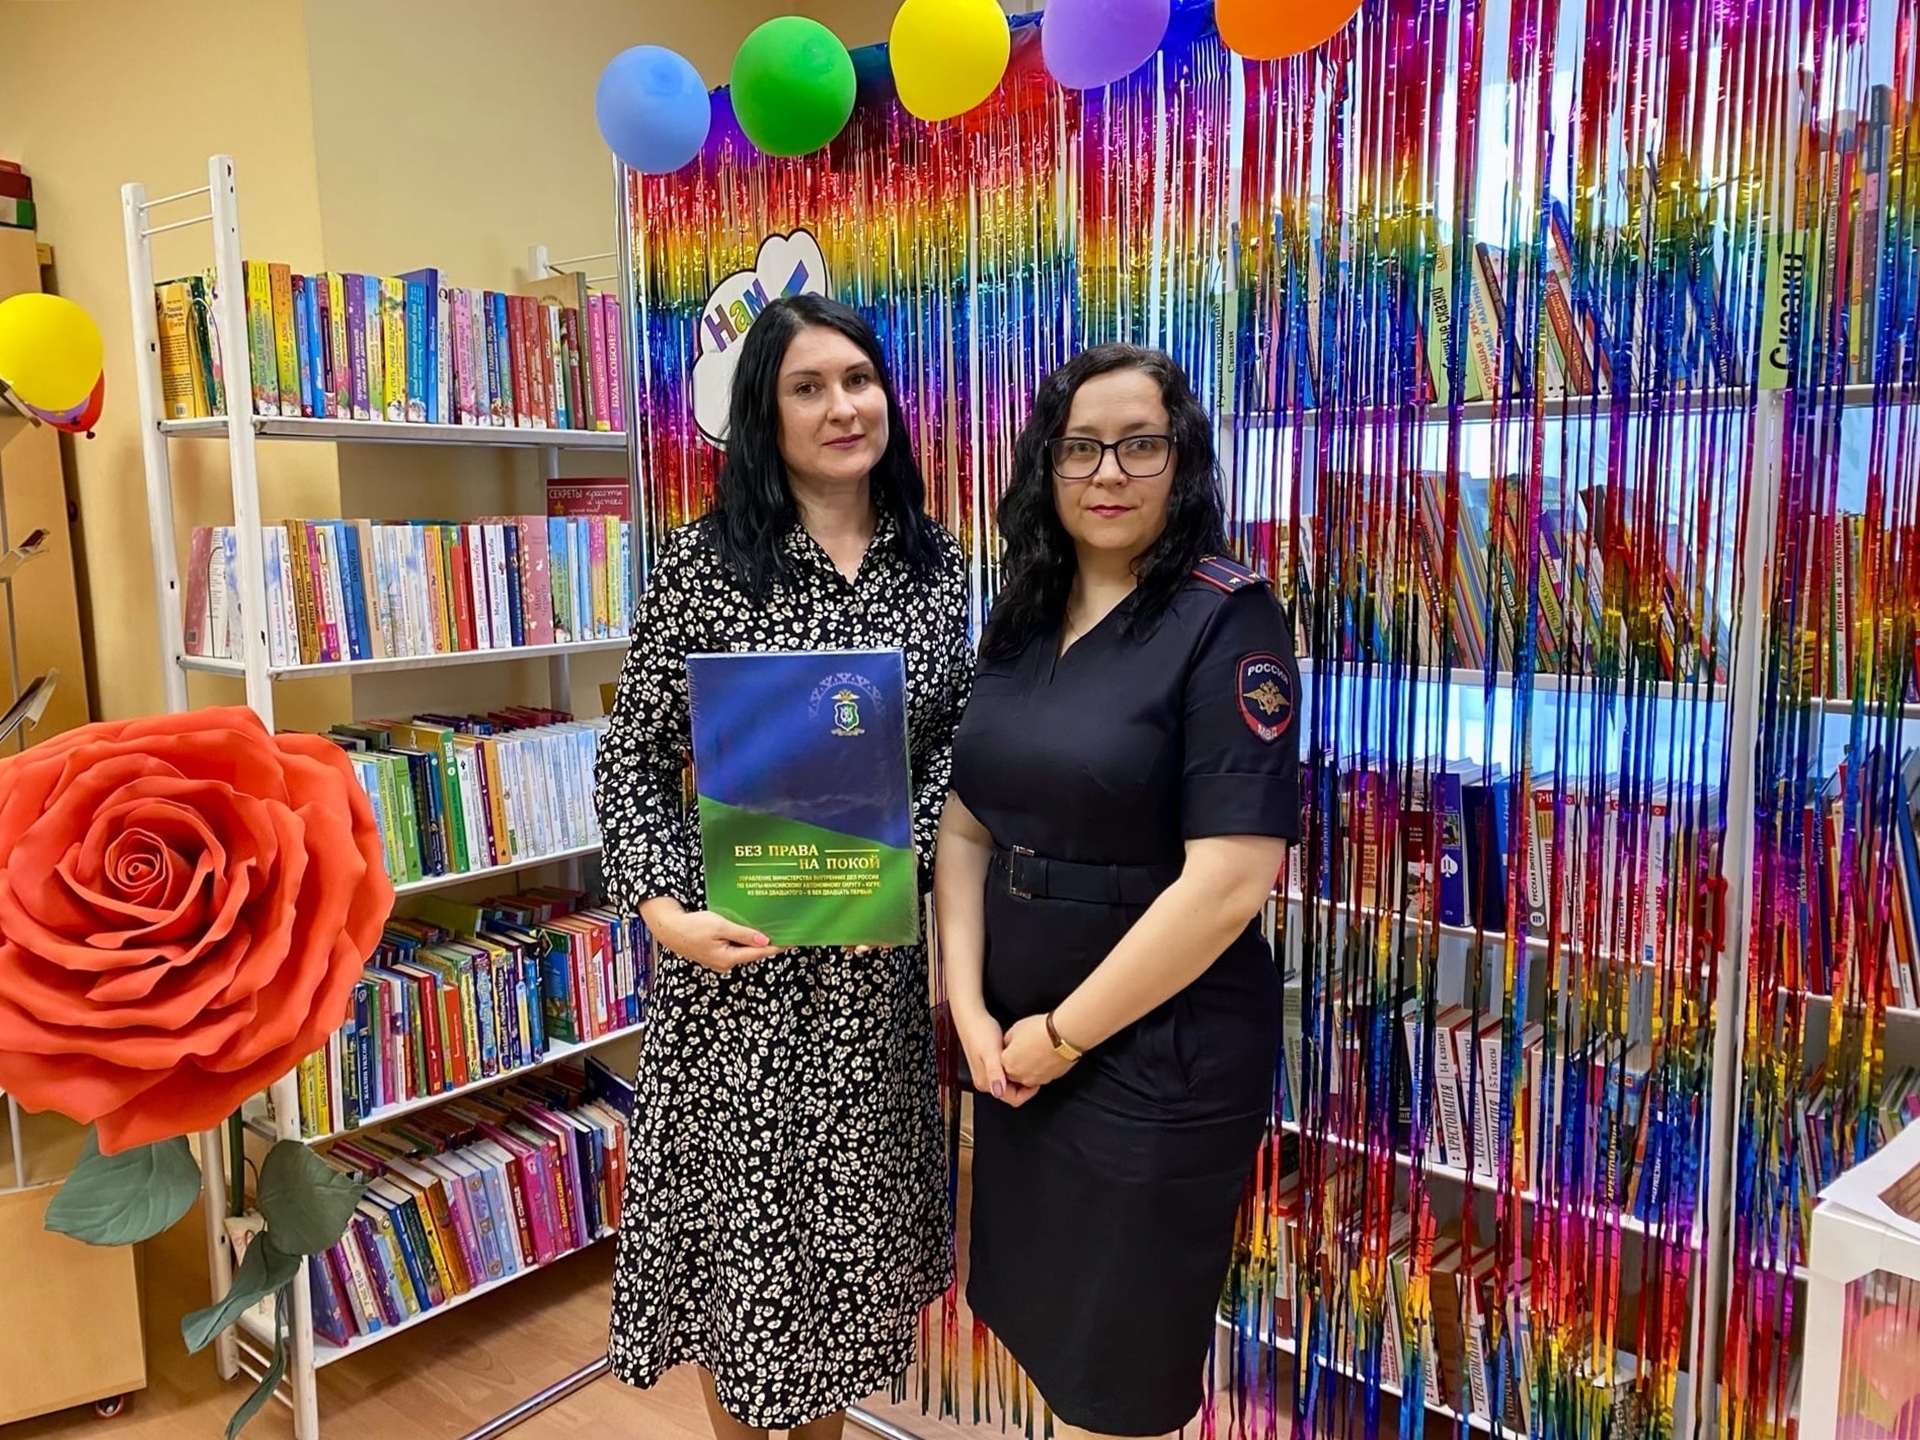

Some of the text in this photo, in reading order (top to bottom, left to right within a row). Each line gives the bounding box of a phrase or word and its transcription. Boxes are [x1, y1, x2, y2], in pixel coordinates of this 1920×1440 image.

[1431, 287, 1450, 322] сказки
[1213, 303, 1225, 407] Русские народные
[1227, 331, 1235, 373] Сказки
[1476, 341, 1494, 390] БОЛЬШАЯ
[608, 335, 619, 407] БУДЬ СОБОЙ!
[549, 489, 623, 499] СЕКРЕТЫ красоты
[1834, 522, 1842, 573] МУЛЬТИКОВ
[1836, 577, 1843, 588] ИЗ
[475, 589, 485, 620] Подарок
[493, 601, 501, 616] Мир
[1836, 592, 1845, 632] ПЕСЕНКИ
[1247, 663, 1288, 685] РОССИЯ
[1257, 724, 1278, 740] МВД
[734, 844, 819, 857] БЕЗ ПРАВА
[799, 855, 880, 869] НА ПОКОЙ
[1528, 831, 1539, 902] РУССКАЯ ЛИТЕРАТУРА
[1438, 1032, 1447, 1060] классы
[1489, 1048, 1497, 1075] классы
[1440, 1083, 1461, 1153] ХРЕСТОМАТИЯ
[1465, 1090, 1486, 1160] ХРЕСТОМАТИЯ
[1489, 1099, 1500, 1168] ХРЕСТОМАТИЯ
[560, 1198, 569, 1227] ПОДАРОК
[1470, 1336, 1485, 1404] ХРЕСТОМАТИЯ
